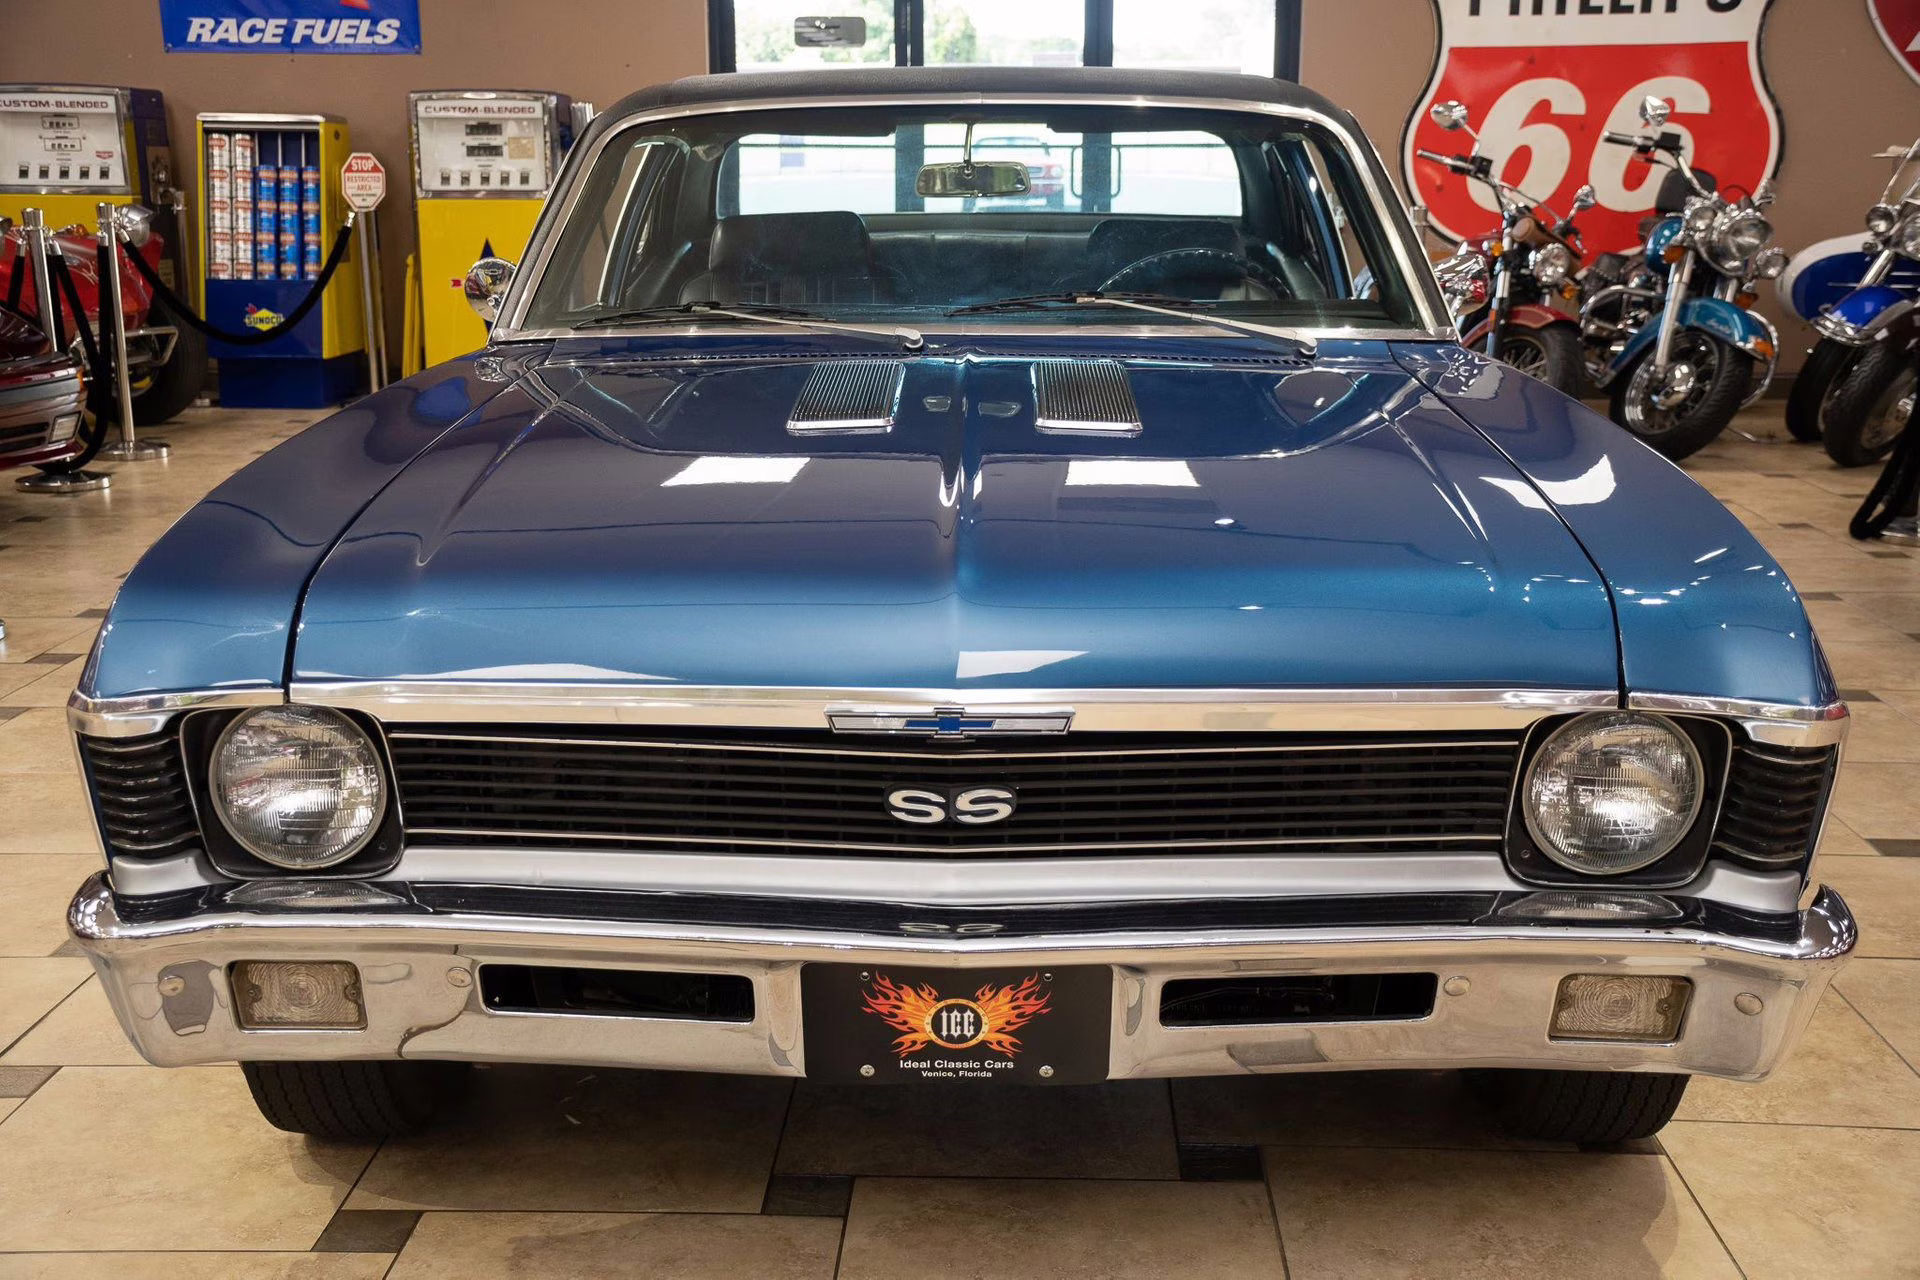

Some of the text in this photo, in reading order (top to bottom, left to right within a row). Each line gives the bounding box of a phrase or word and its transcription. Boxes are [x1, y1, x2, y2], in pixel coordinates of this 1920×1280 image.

[186, 17, 401, 45] RACE FUELS
[0, 99, 109, 109] USTOM-BLENDED
[1466, 76, 1710, 213] 66
[351, 158, 374, 171] STOP
[346, 175, 381, 183] RESTRICTED
[357, 183, 372, 191] AREA
[888, 788, 1013, 824] SS
[899, 1059, 1014, 1069] Ideal Classic Cars
[921, 1070, 992, 1079] Venice, Florida
